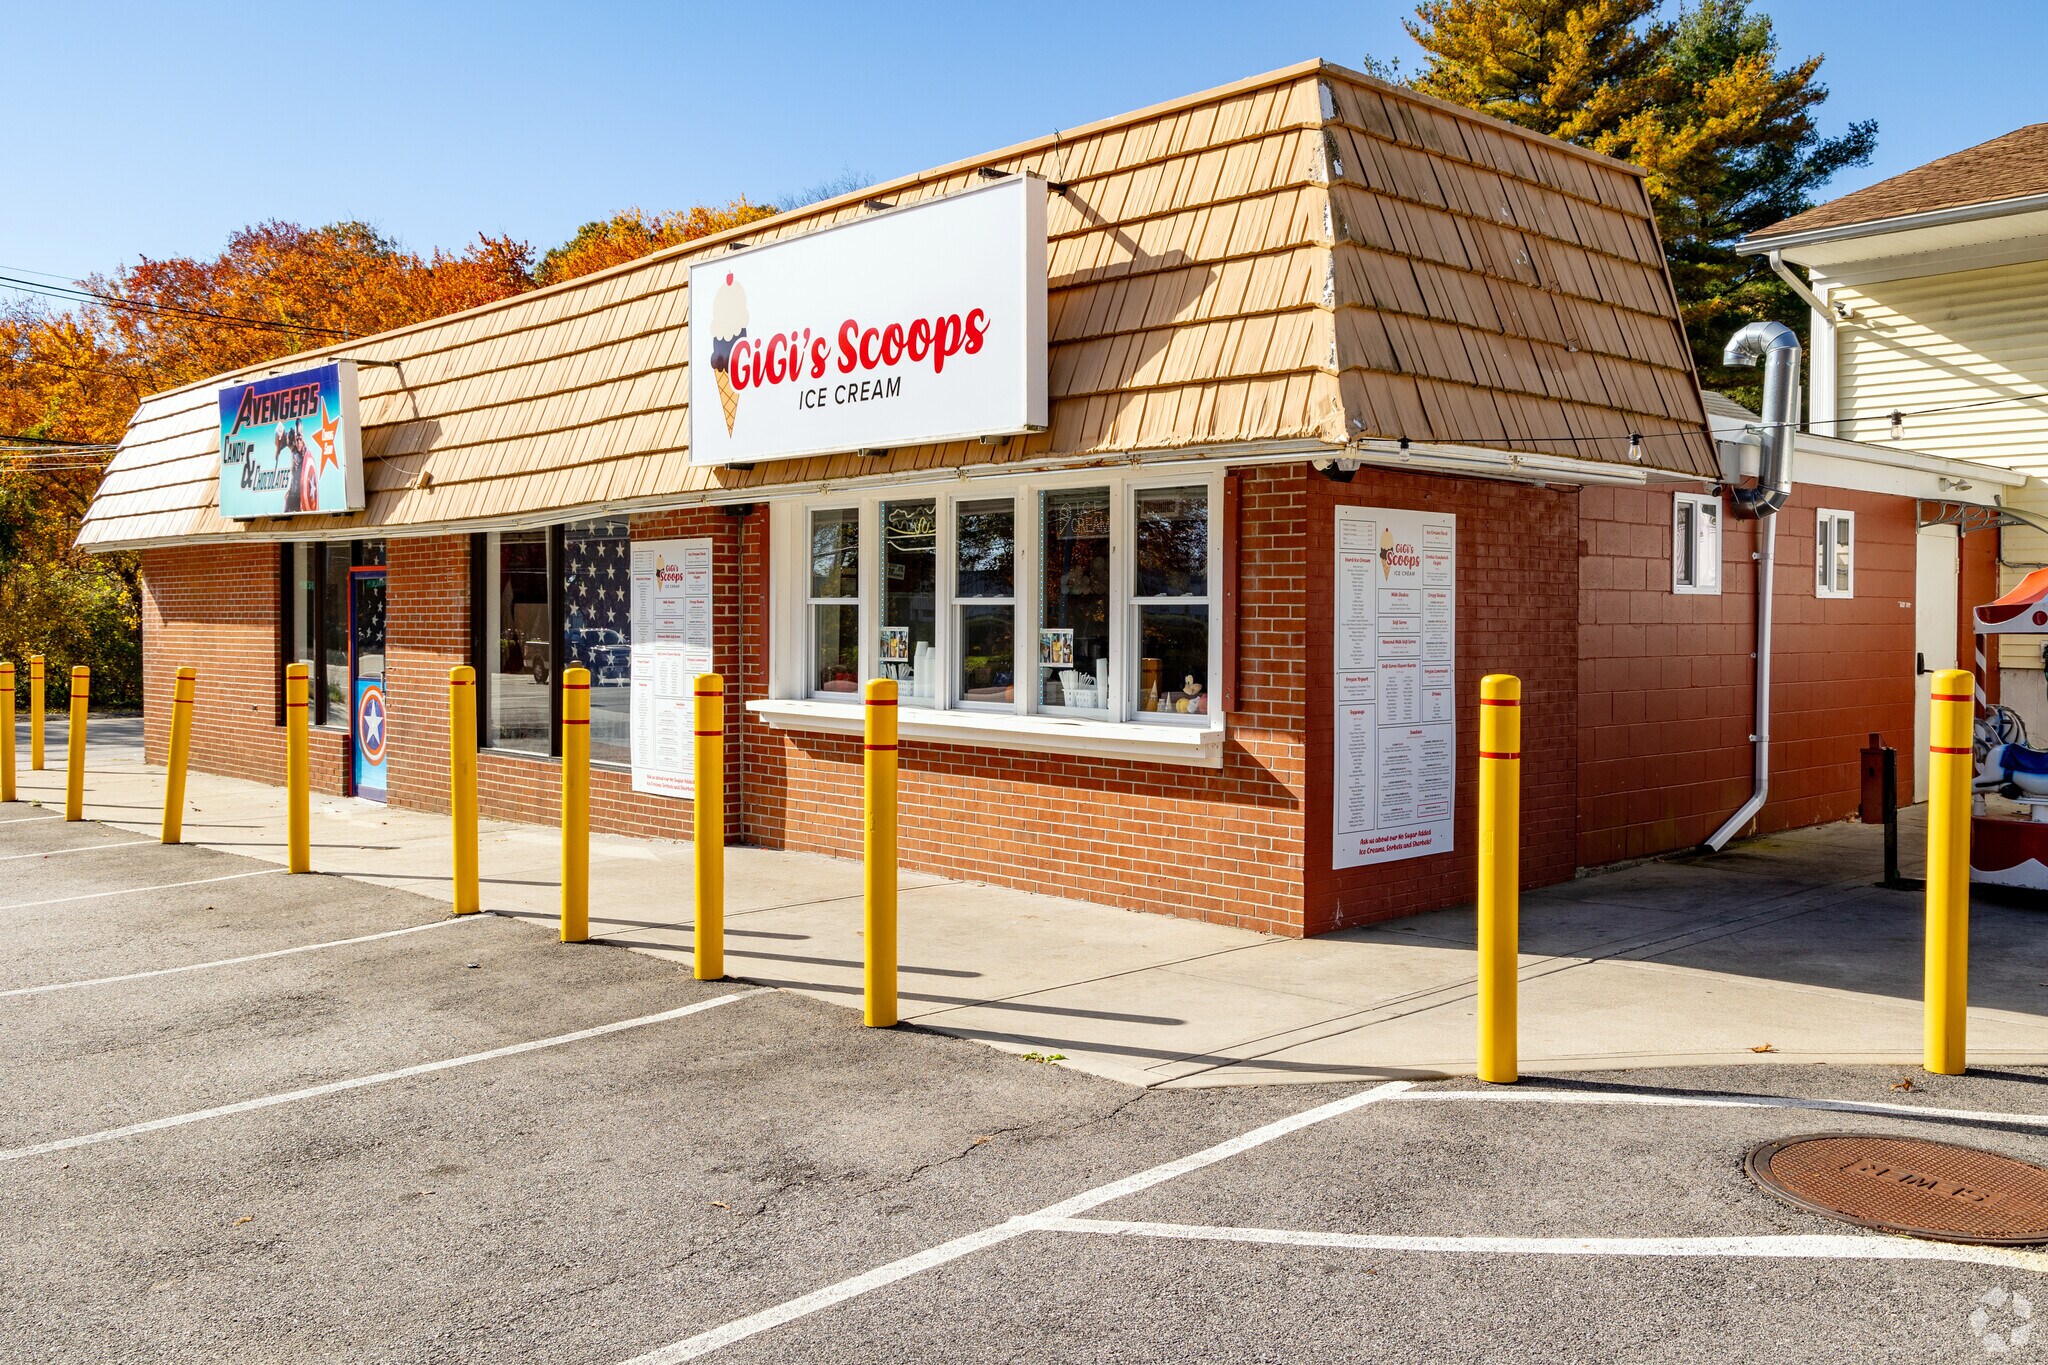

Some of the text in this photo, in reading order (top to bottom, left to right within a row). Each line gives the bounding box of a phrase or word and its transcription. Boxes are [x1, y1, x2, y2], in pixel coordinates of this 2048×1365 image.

[730, 307, 991, 391] GiGi's Scoops
[799, 376, 902, 410] ICE CREAM
[231, 382, 320, 436] AVENGERS
[240, 443, 256, 489] &
[1395, 543, 1414, 554] GiGi's
[665, 564, 679, 572] GiGi's
[1386, 551, 1421, 570] Scoops
[660, 571, 683, 583] Scoops
[1404, 832, 1418, 840] Sugar
[1403, 841, 1412, 849] and
